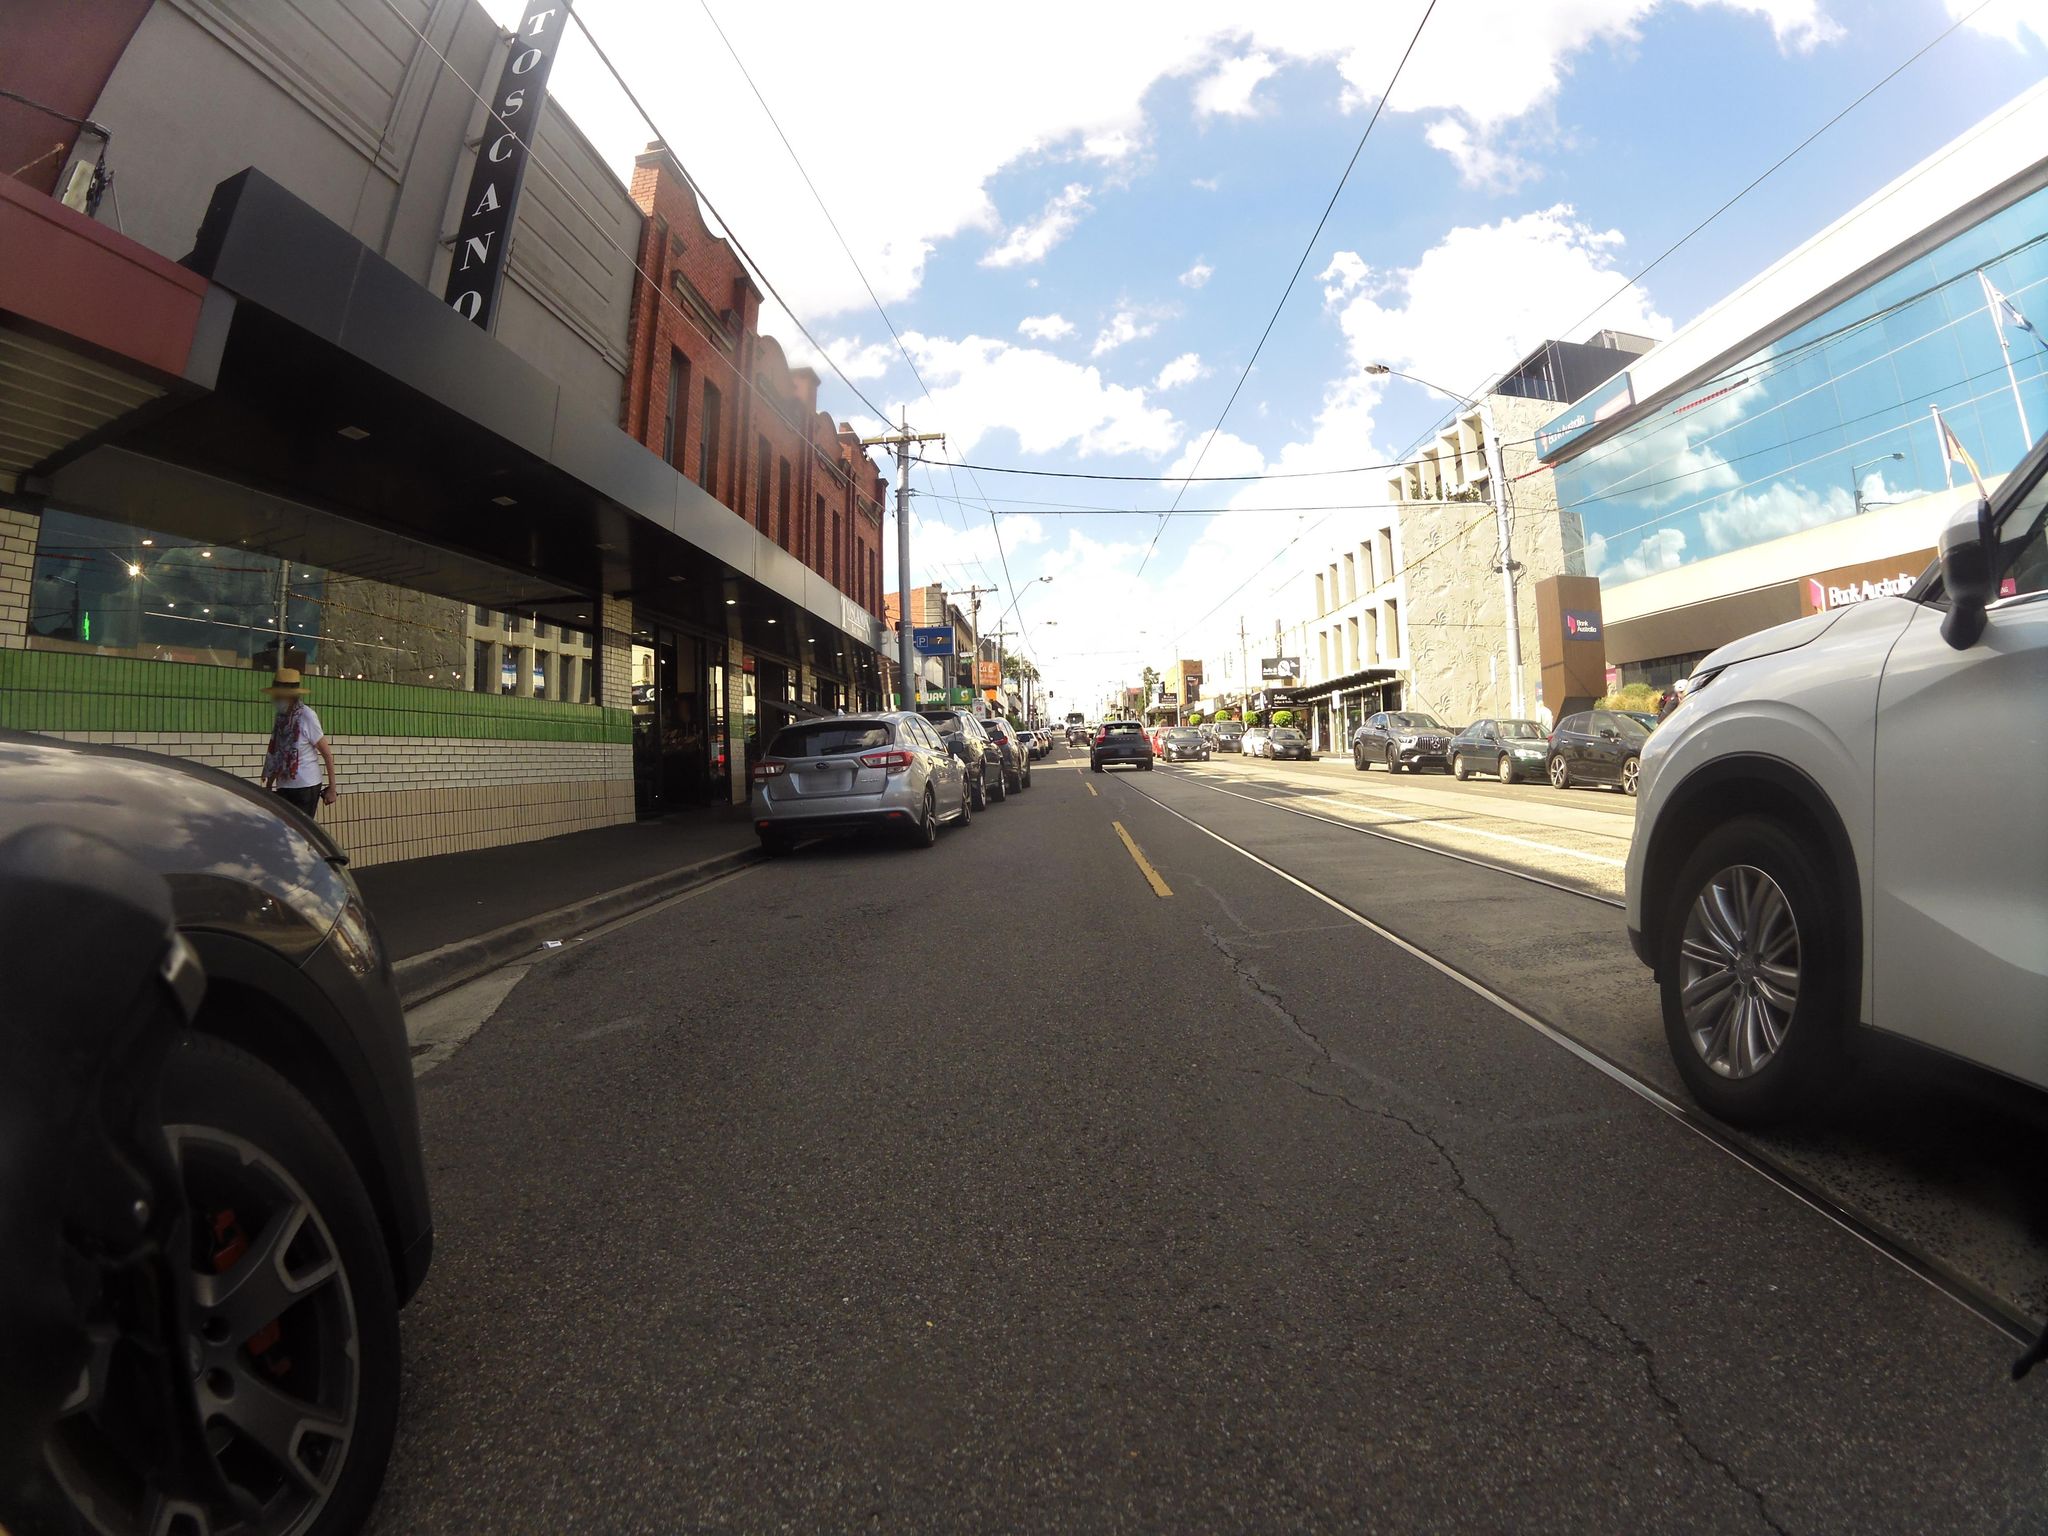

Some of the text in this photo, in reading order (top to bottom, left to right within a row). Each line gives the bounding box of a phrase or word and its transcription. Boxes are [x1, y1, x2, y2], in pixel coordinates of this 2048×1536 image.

[453, 8, 556, 321] TOSCANO
[1828, 572, 1918, 607] Bank Australia
[936, 636, 943, 645] 7
